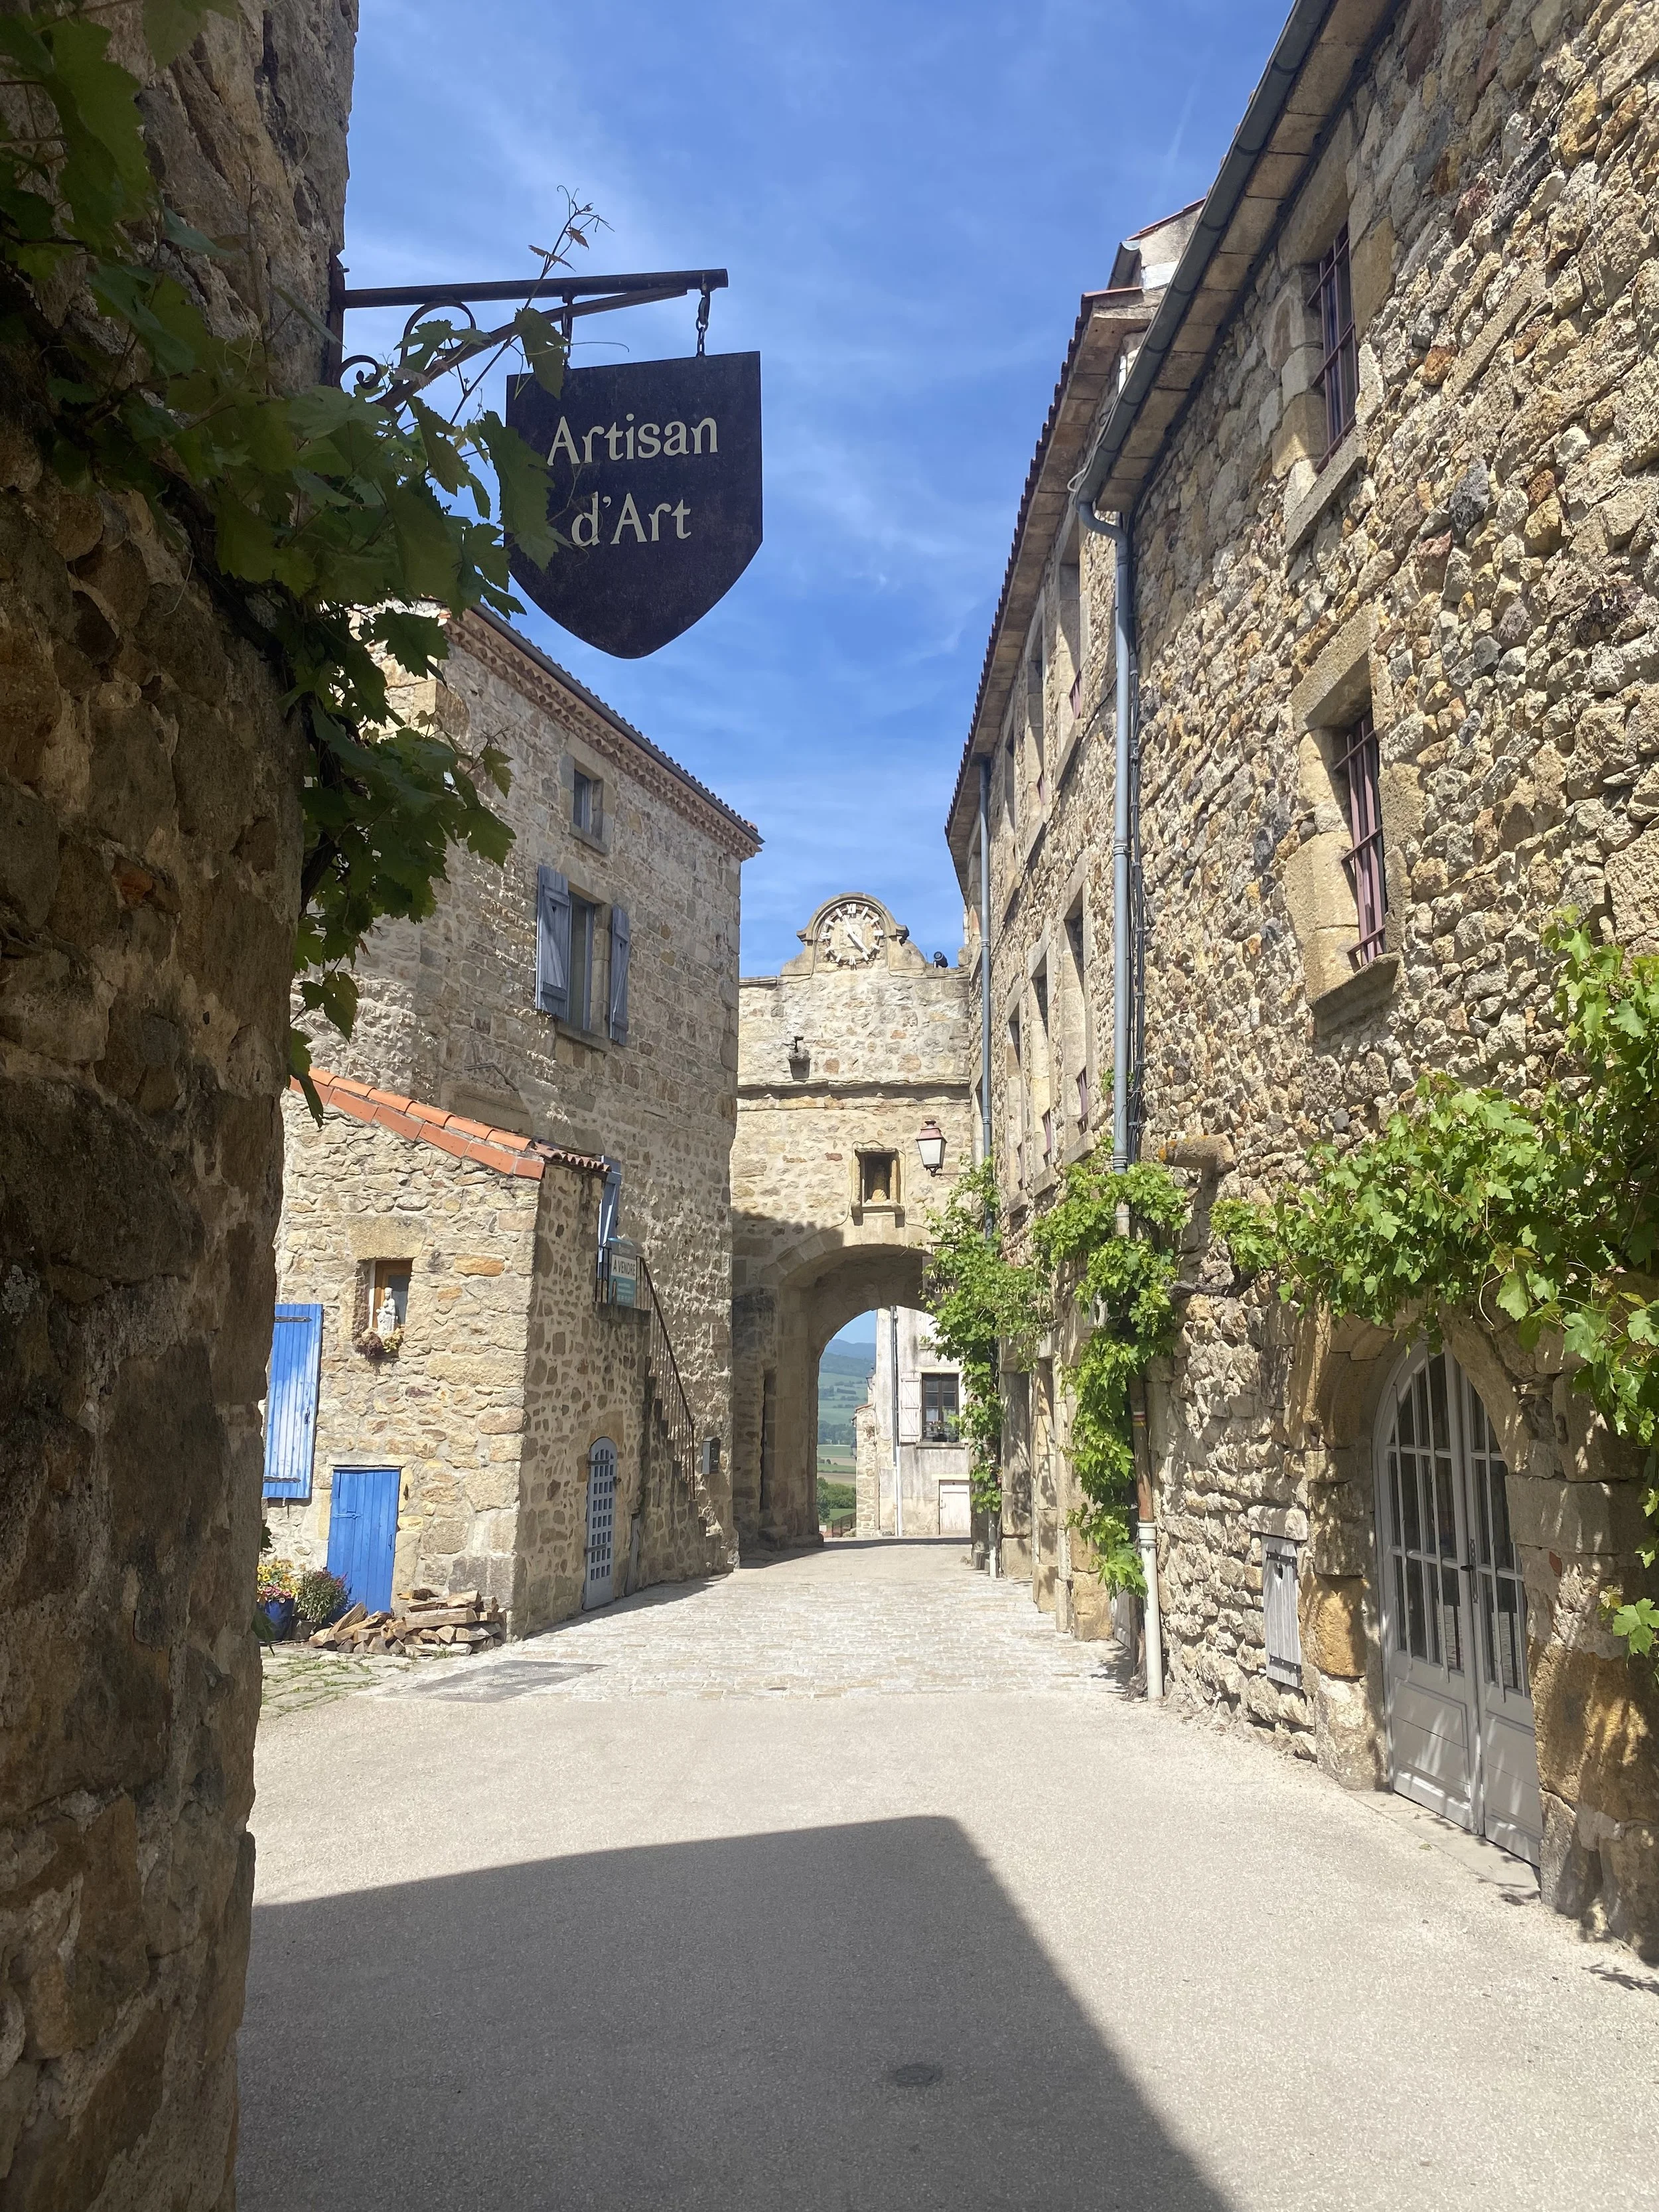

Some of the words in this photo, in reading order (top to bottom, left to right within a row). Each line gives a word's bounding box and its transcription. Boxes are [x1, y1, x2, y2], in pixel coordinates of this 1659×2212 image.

[547, 413, 718, 466] Artisan
[571, 491, 691, 546] d'Art
[618, 1260, 636, 1276] VENDRE
[934, 1283, 955, 1293] d'Art
